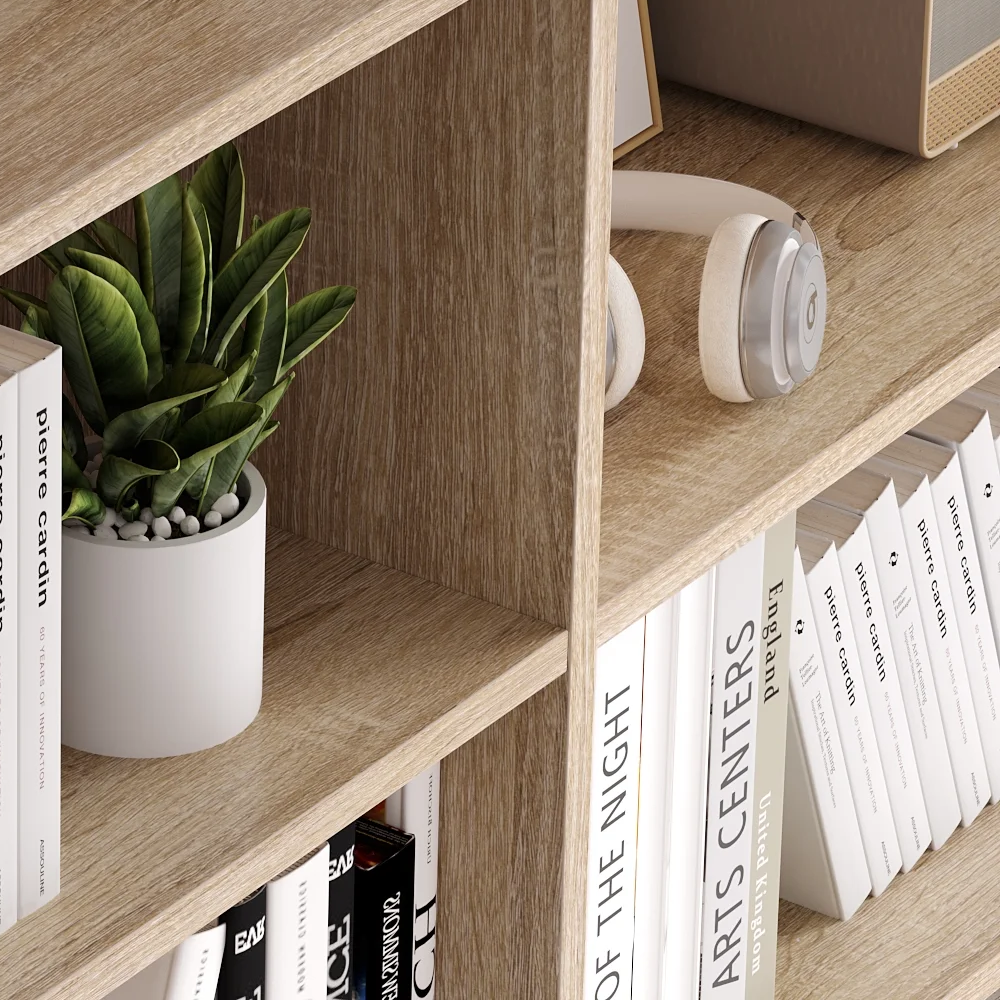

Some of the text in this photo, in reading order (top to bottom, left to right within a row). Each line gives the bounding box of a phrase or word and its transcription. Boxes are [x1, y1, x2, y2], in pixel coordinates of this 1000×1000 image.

[36, 407, 50, 607] pierre cardin
[947, 495, 977, 615] pierre cardin
[39, 626, 45, 641] 60
[855, 561, 887, 683] pierre cardin
[908, 622, 916, 640] The
[917, 518, 948, 639] pierre cardin
[39, 691, 46, 707] OF
[762, 578, 784, 704] England
[824, 585, 856, 707] pierre cardin
[818, 710, 826, 725] Art
[822, 724, 828, 735] of
[823, 735, 836, 775] Knitting
[594, 685, 631, 1000] OF THE NIGHT
[712, 619, 756, 988] ARTS CENTERS
[750, 790, 772, 976] United Kingdom
